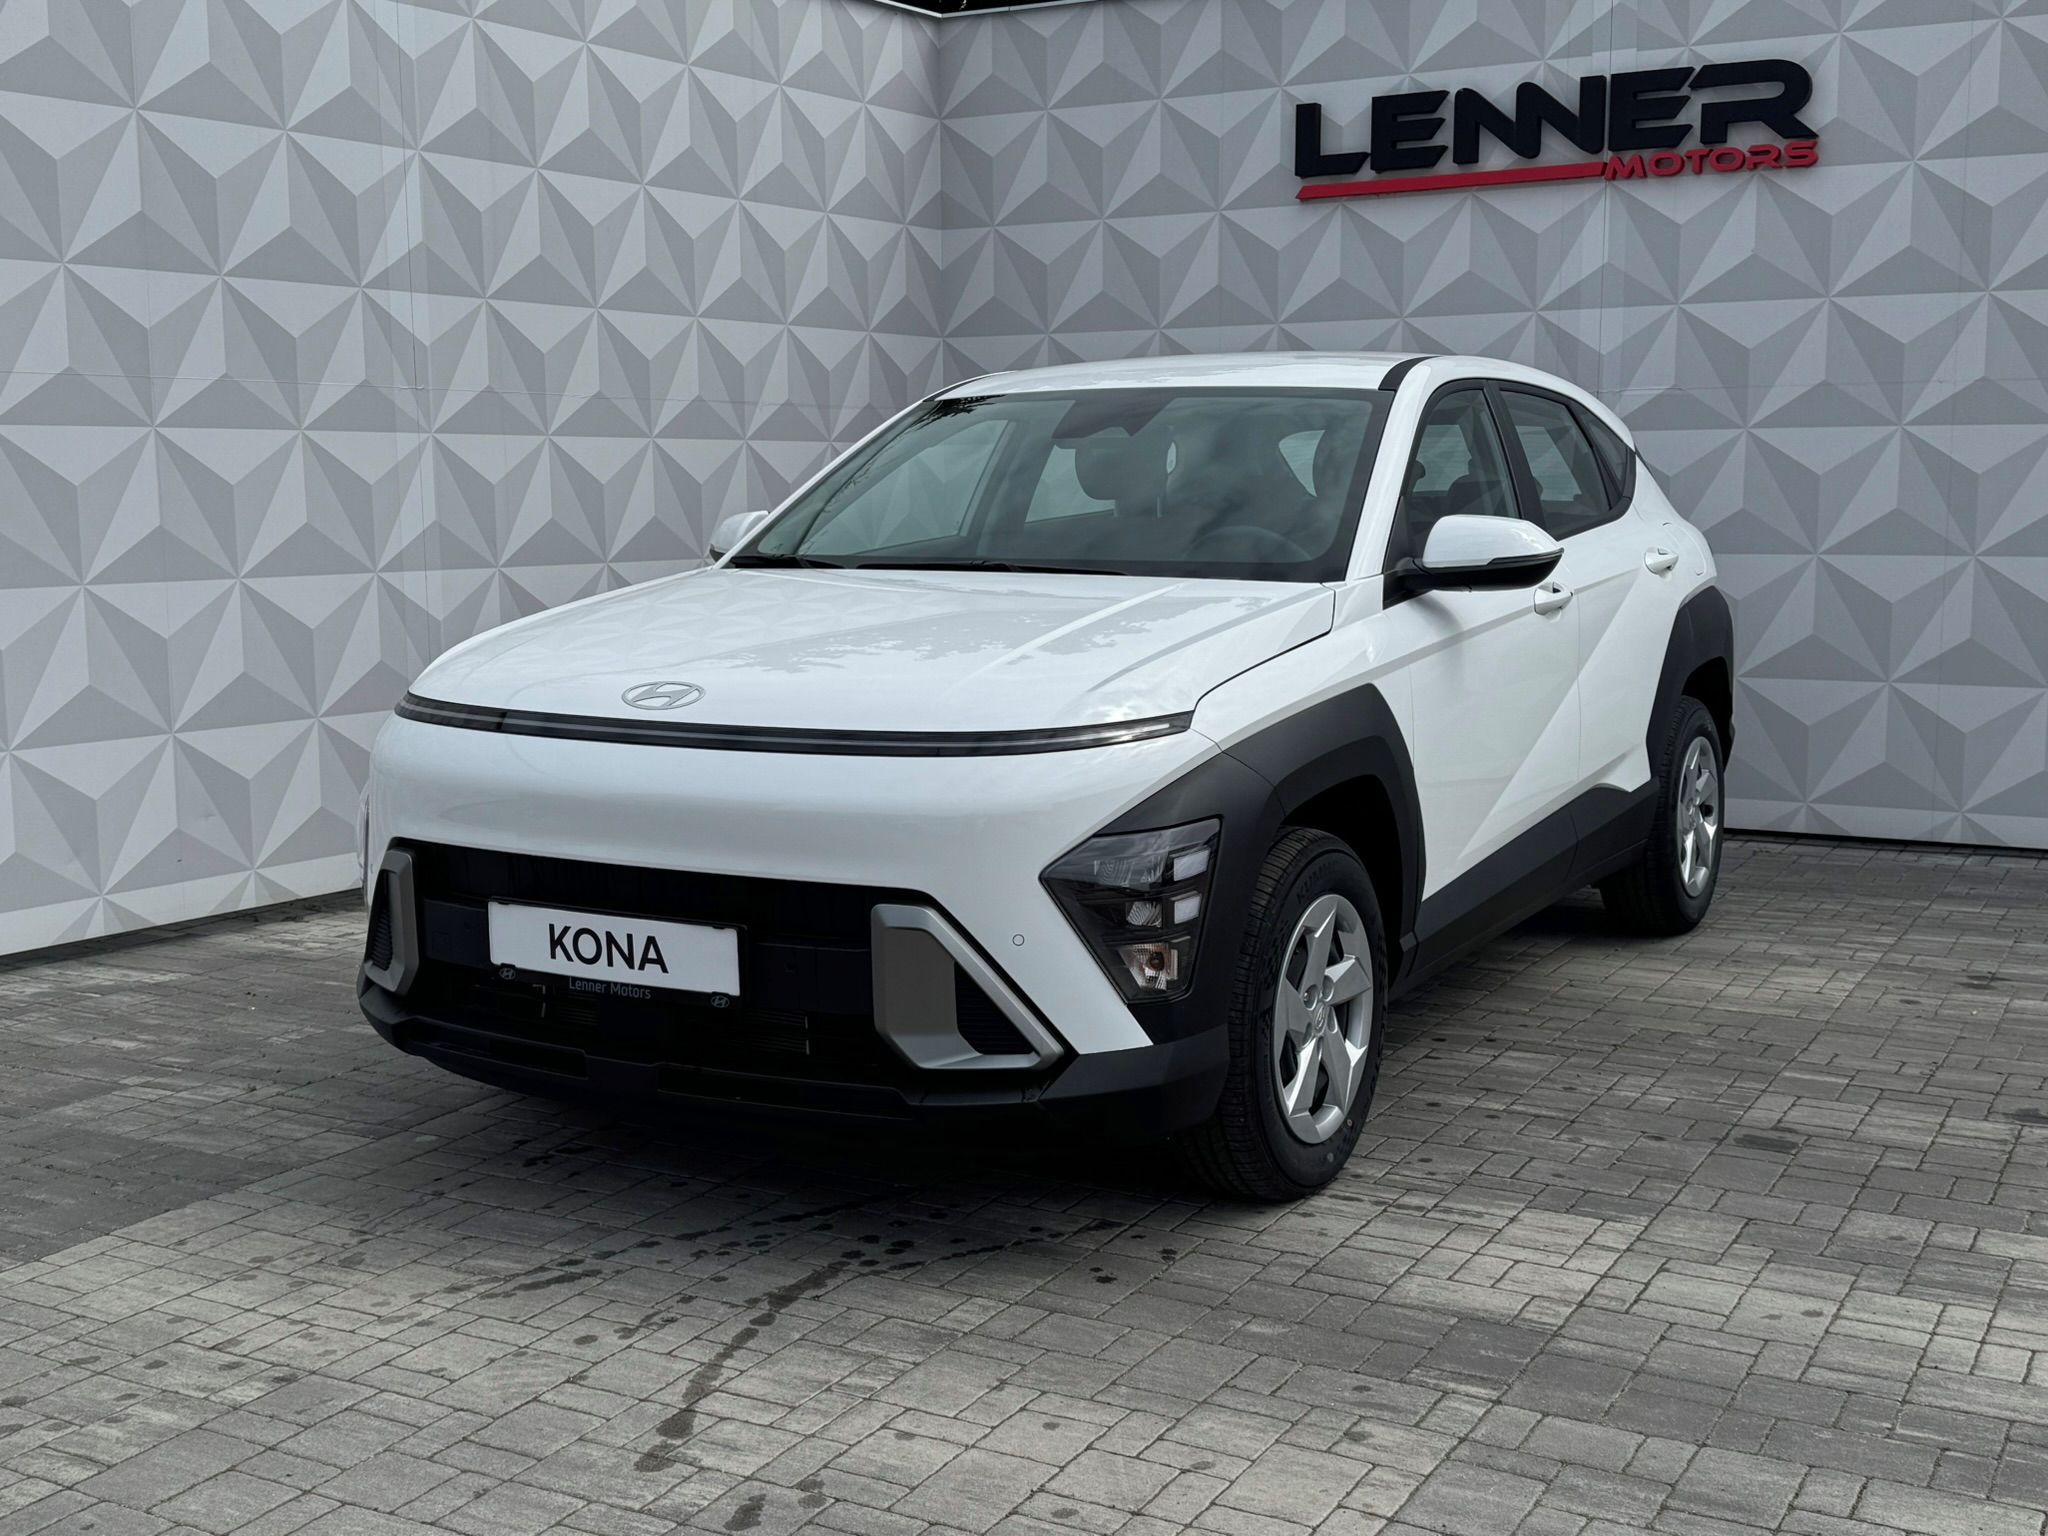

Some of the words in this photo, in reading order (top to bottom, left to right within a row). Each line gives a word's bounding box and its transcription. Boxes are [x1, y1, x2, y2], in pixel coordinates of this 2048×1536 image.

[1295, 59, 1819, 178] LENNER
[1604, 139, 1819, 181] MOTORS
[548, 923, 669, 974] KONA
[569, 976, 607, 993] Lenner
[610, 983, 651, 999] Motors
